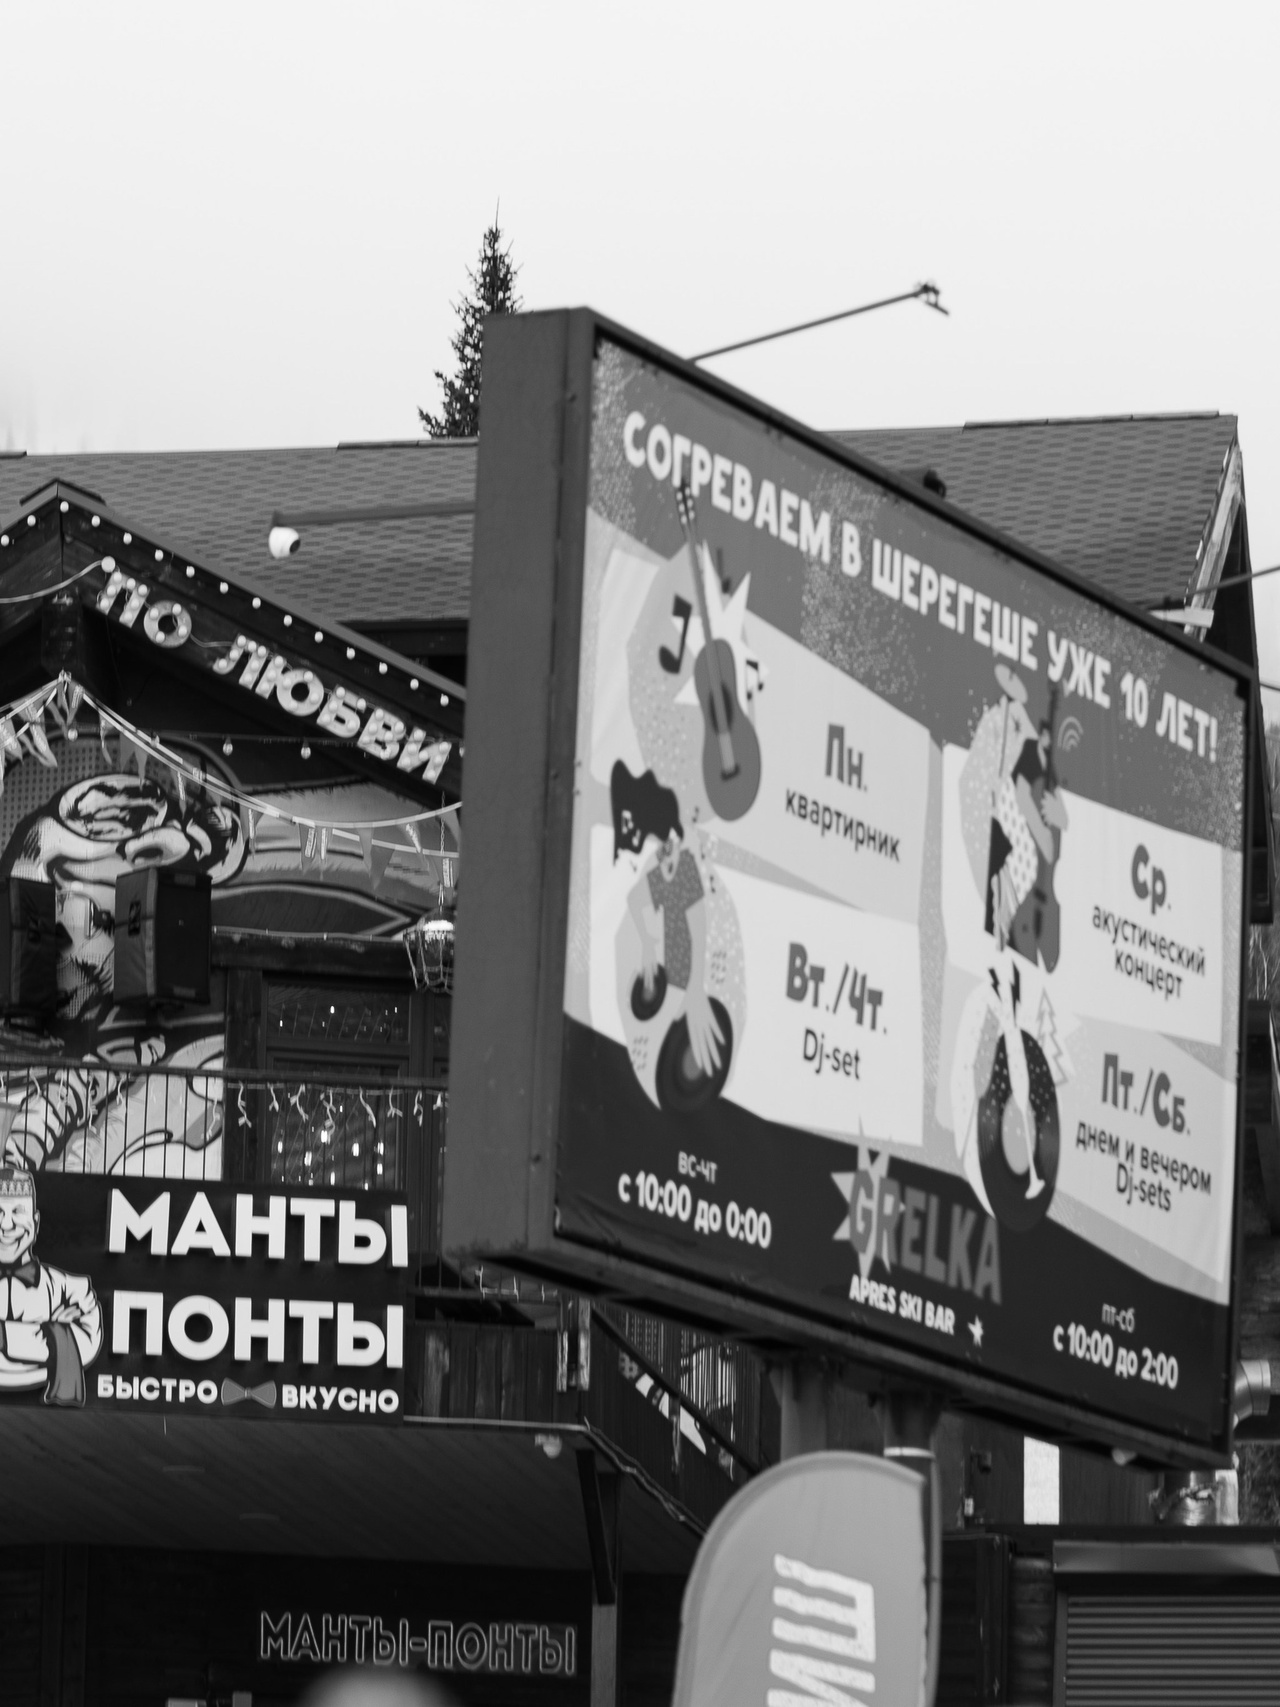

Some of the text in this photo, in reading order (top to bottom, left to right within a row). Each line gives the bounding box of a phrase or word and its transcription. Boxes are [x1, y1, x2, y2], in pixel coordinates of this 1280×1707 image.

[622, 410, 1219, 764] СОГРЕВАЕМ В ШЕРЕГЕШЕ УЖЕ 10 ЛЕТ!
[96, 571, 192, 648] ПО
[212, 633, 452, 785] ЛЮБВИ
[825, 723, 868, 792] Пн.
[785, 788, 901, 863] квартирник
[1131, 843, 1172, 916] Ср.
[1092, 904, 1207, 977] акустический
[1114, 948, 1184, 1001] концерт
[803, 1027, 862, 1081] Dj-set
[1076, 1120, 1213, 1196] днем и вечером
[1116, 1162, 1173, 1212] Dj-sets
[108, 1187, 409, 1268] МАНТЫ
[635, 1170, 693, 1223] 10:00
[694, 1199, 722, 1235] до
[725, 1200, 773, 1249] 0:00
[848, 1168, 1003, 1307] GRELKA
[111, 1289, 405, 1369] ПОНТЫ
[849, 1273, 956, 1336] APRES SKI BAR
[1067, 1321, 1114, 1369] 10:00
[1115, 1345, 1138, 1380] до
[1140, 1346, 1180, 1390] 2:00
[97, 1373, 400, 1414] БЫСТРО ВКУСНО
[259, 1611, 577, 1677] МАНТЫ-ПОНТЫ
